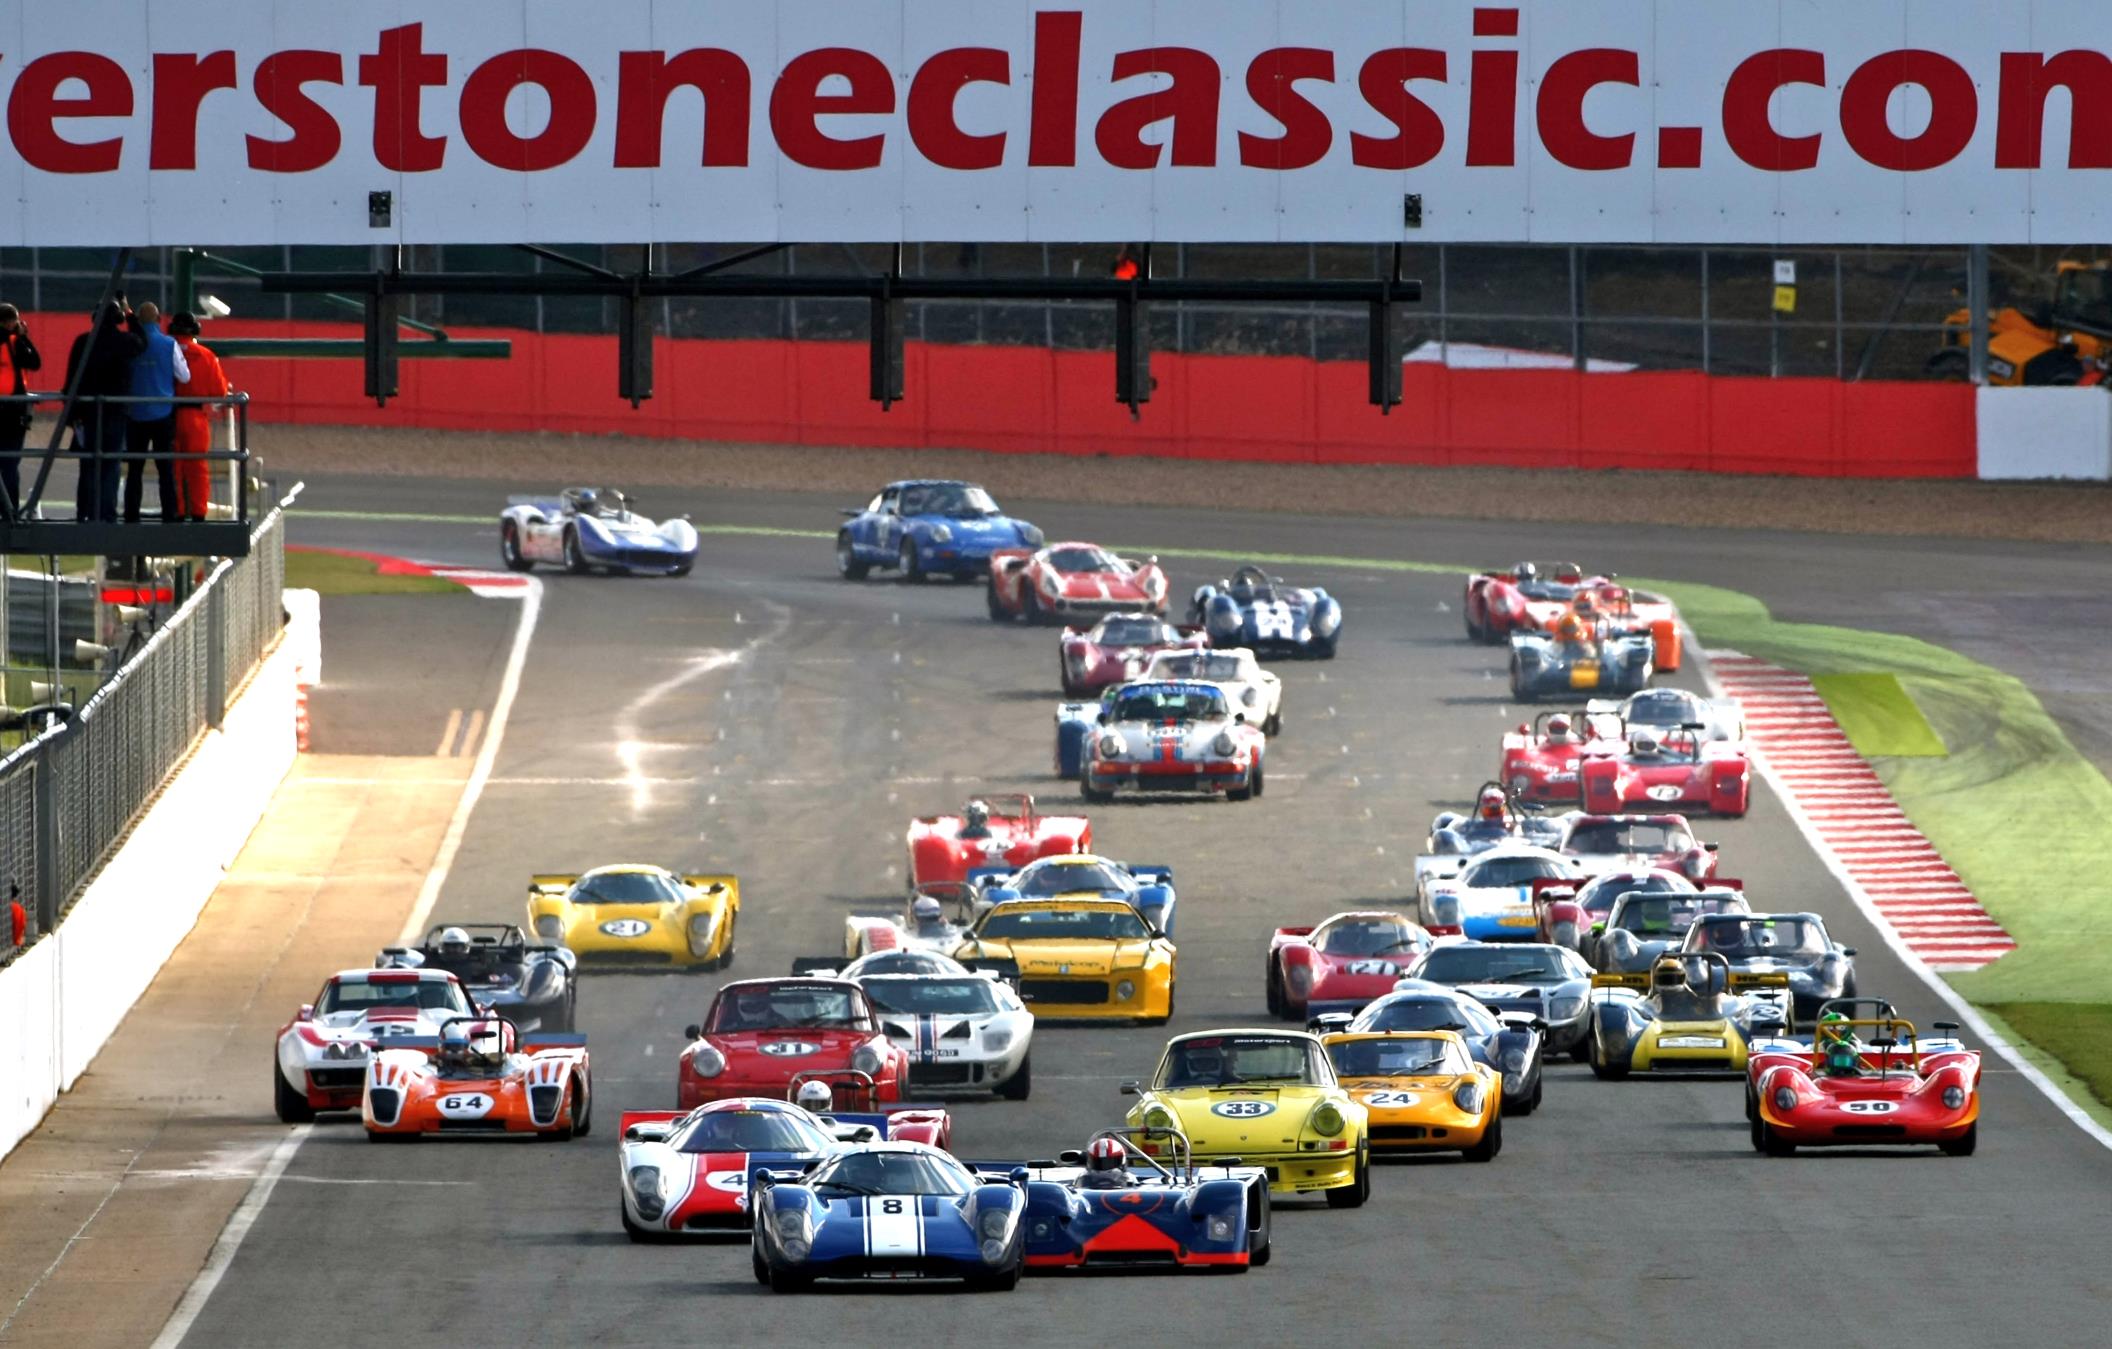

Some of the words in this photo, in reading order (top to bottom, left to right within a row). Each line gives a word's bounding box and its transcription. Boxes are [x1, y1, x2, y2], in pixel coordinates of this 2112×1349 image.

[445, 1096, 482, 1109] 64
[1371, 1093, 1411, 1104] 24
[1226, 1103, 1262, 1115] 33
[1850, 1102, 1890, 1112] 50
[1120, 1192, 1142, 1204] 4
[882, 1199, 902, 1214] 8
